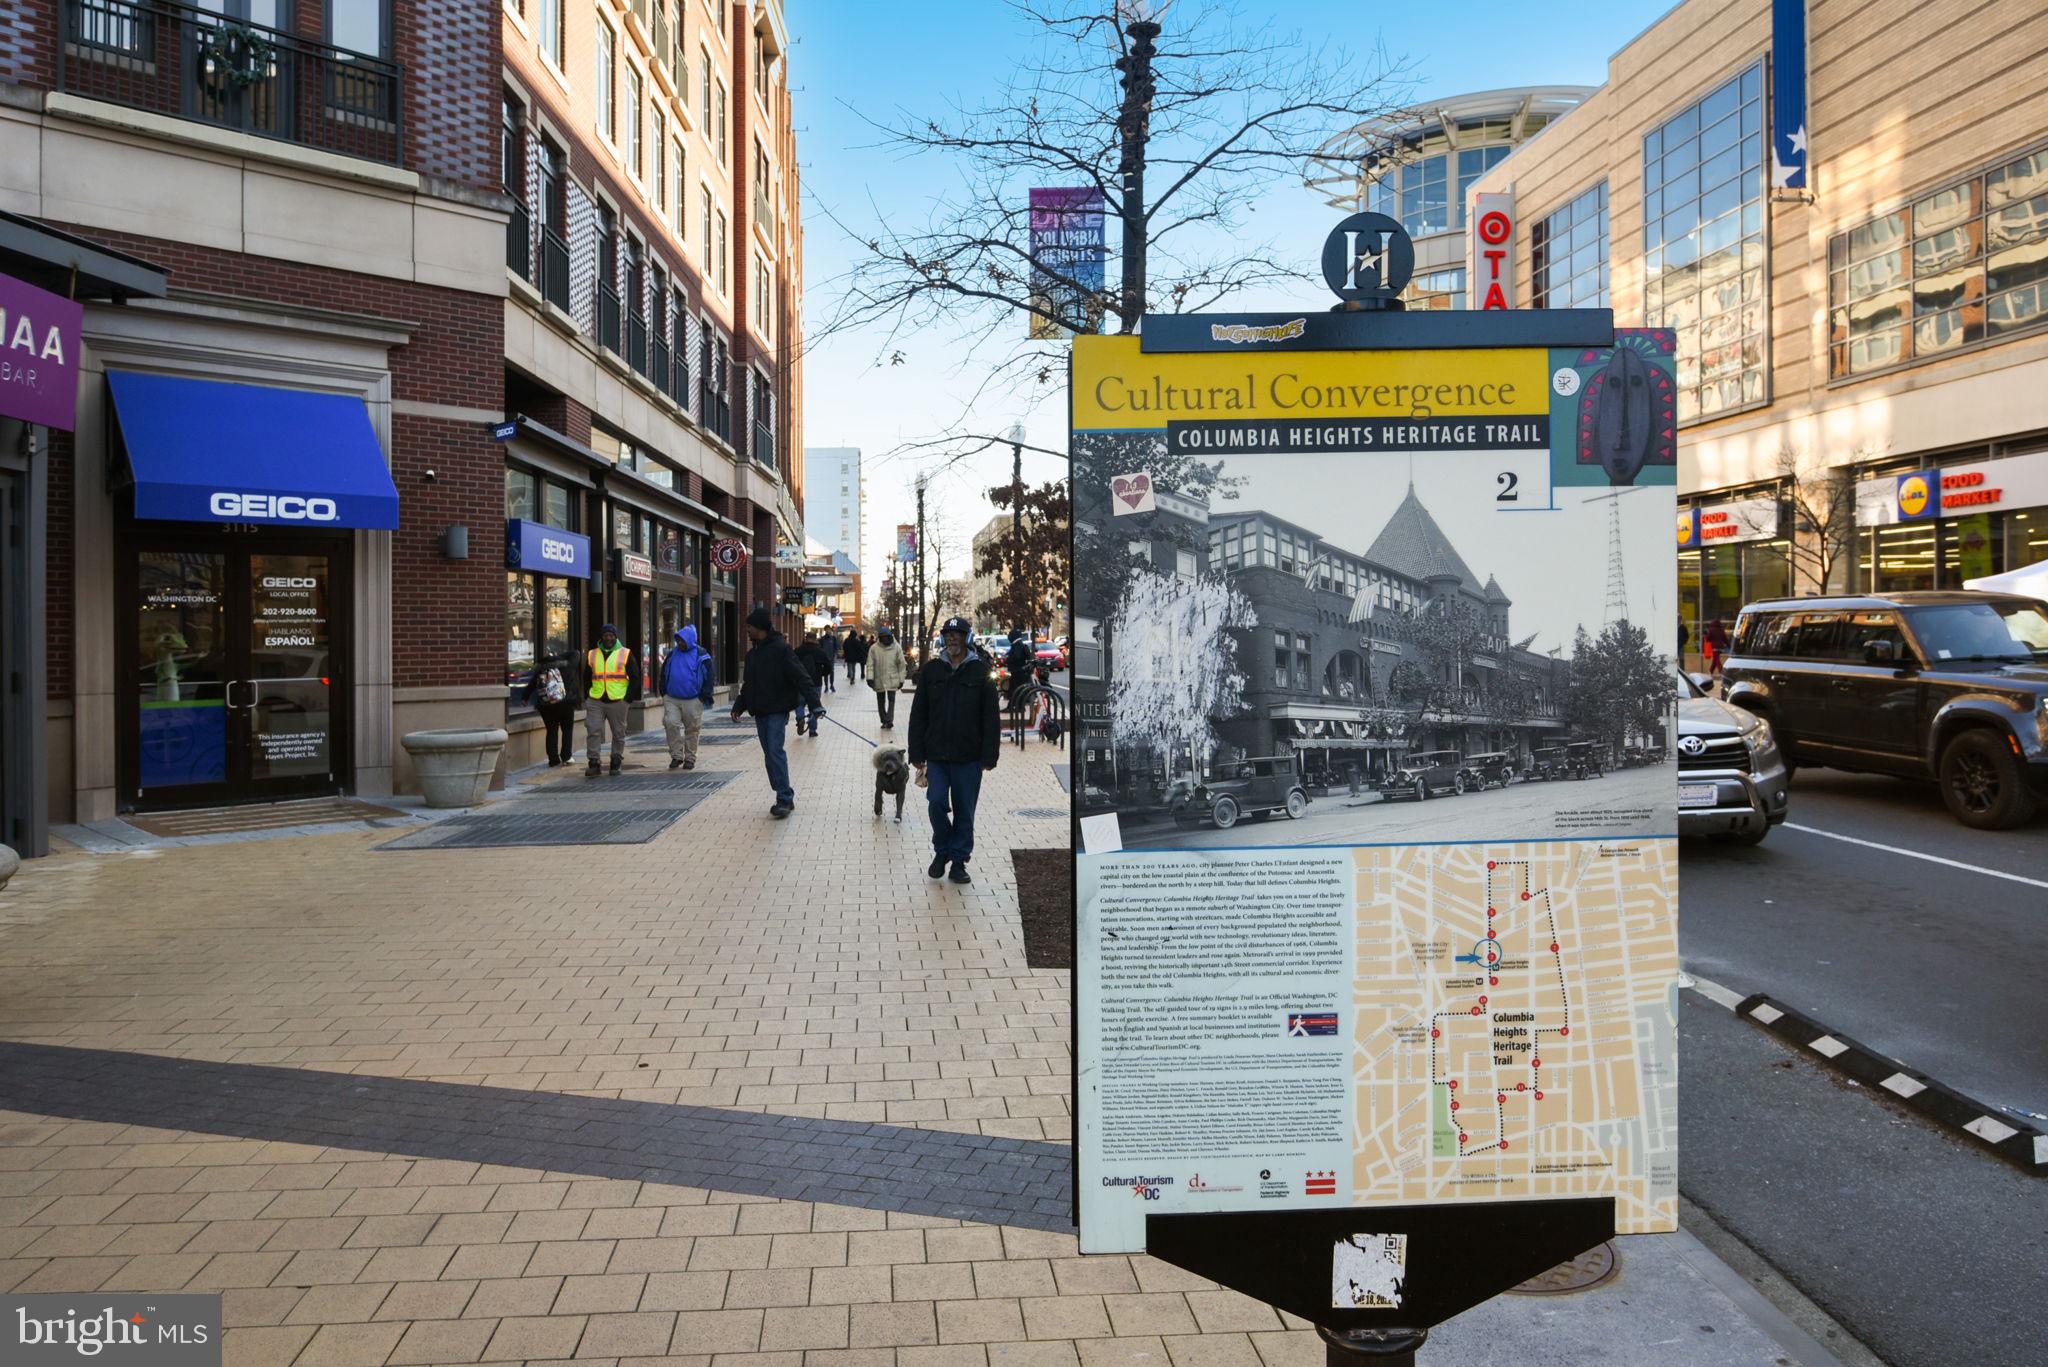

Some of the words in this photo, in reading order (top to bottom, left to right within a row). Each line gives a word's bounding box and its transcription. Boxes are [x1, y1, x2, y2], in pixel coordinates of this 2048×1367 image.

[1035, 230, 1100, 246] COLUMBIA
[1096, 374, 1256, 413] Cultural
[1270, 371, 1516, 420] Convergence
[496, 426, 514, 438] GEICO
[1178, 426, 1280, 448] COLUMBIA
[1290, 424, 1374, 447] HEIGHTS
[1382, 424, 1477, 446] HERITAGE
[1485, 423, 1541, 444] TRAIL
[1942, 472, 1984, 489] FOOD
[1496, 472, 1518, 502] 2
[1942, 488, 2002, 508] MARKET
[210, 492, 337, 521] GEICO
[1700, 512, 1728, 524] FOOD
[1700, 525, 1738, 540] MARKET
[542, 538, 574, 564] GEICO
[713, 539, 744, 552] CHIPOTLE
[263, 577, 316, 588] GEICO
[265, 636, 314, 646] ESPAÑOL!
[1200, 861, 1210, 869] city
[1211, 861, 1234, 869] planner
[1300, 859, 1326, 868] designed
[1100, 873, 1120, 881] capital
[1120, 872, 1132, 881] city
[1185, 871, 1200, 880] plain
[1185, 881, 1192, 889] by
[1198, 880, 1213, 889] steep
[1227, 880, 1244, 888] Today
[1494, 1012, 1534, 1022] Columbia
[1494, 1027, 1527, 1038] Heights
[1494, 1041, 1532, 1052] Heritage
[1494, 1055, 1512, 1065] Trail
[1103, 1176, 1137, 1187] Cultural
[1139, 1175, 1174, 1185] Tourism
[1144, 1188, 1160, 1200] DC
